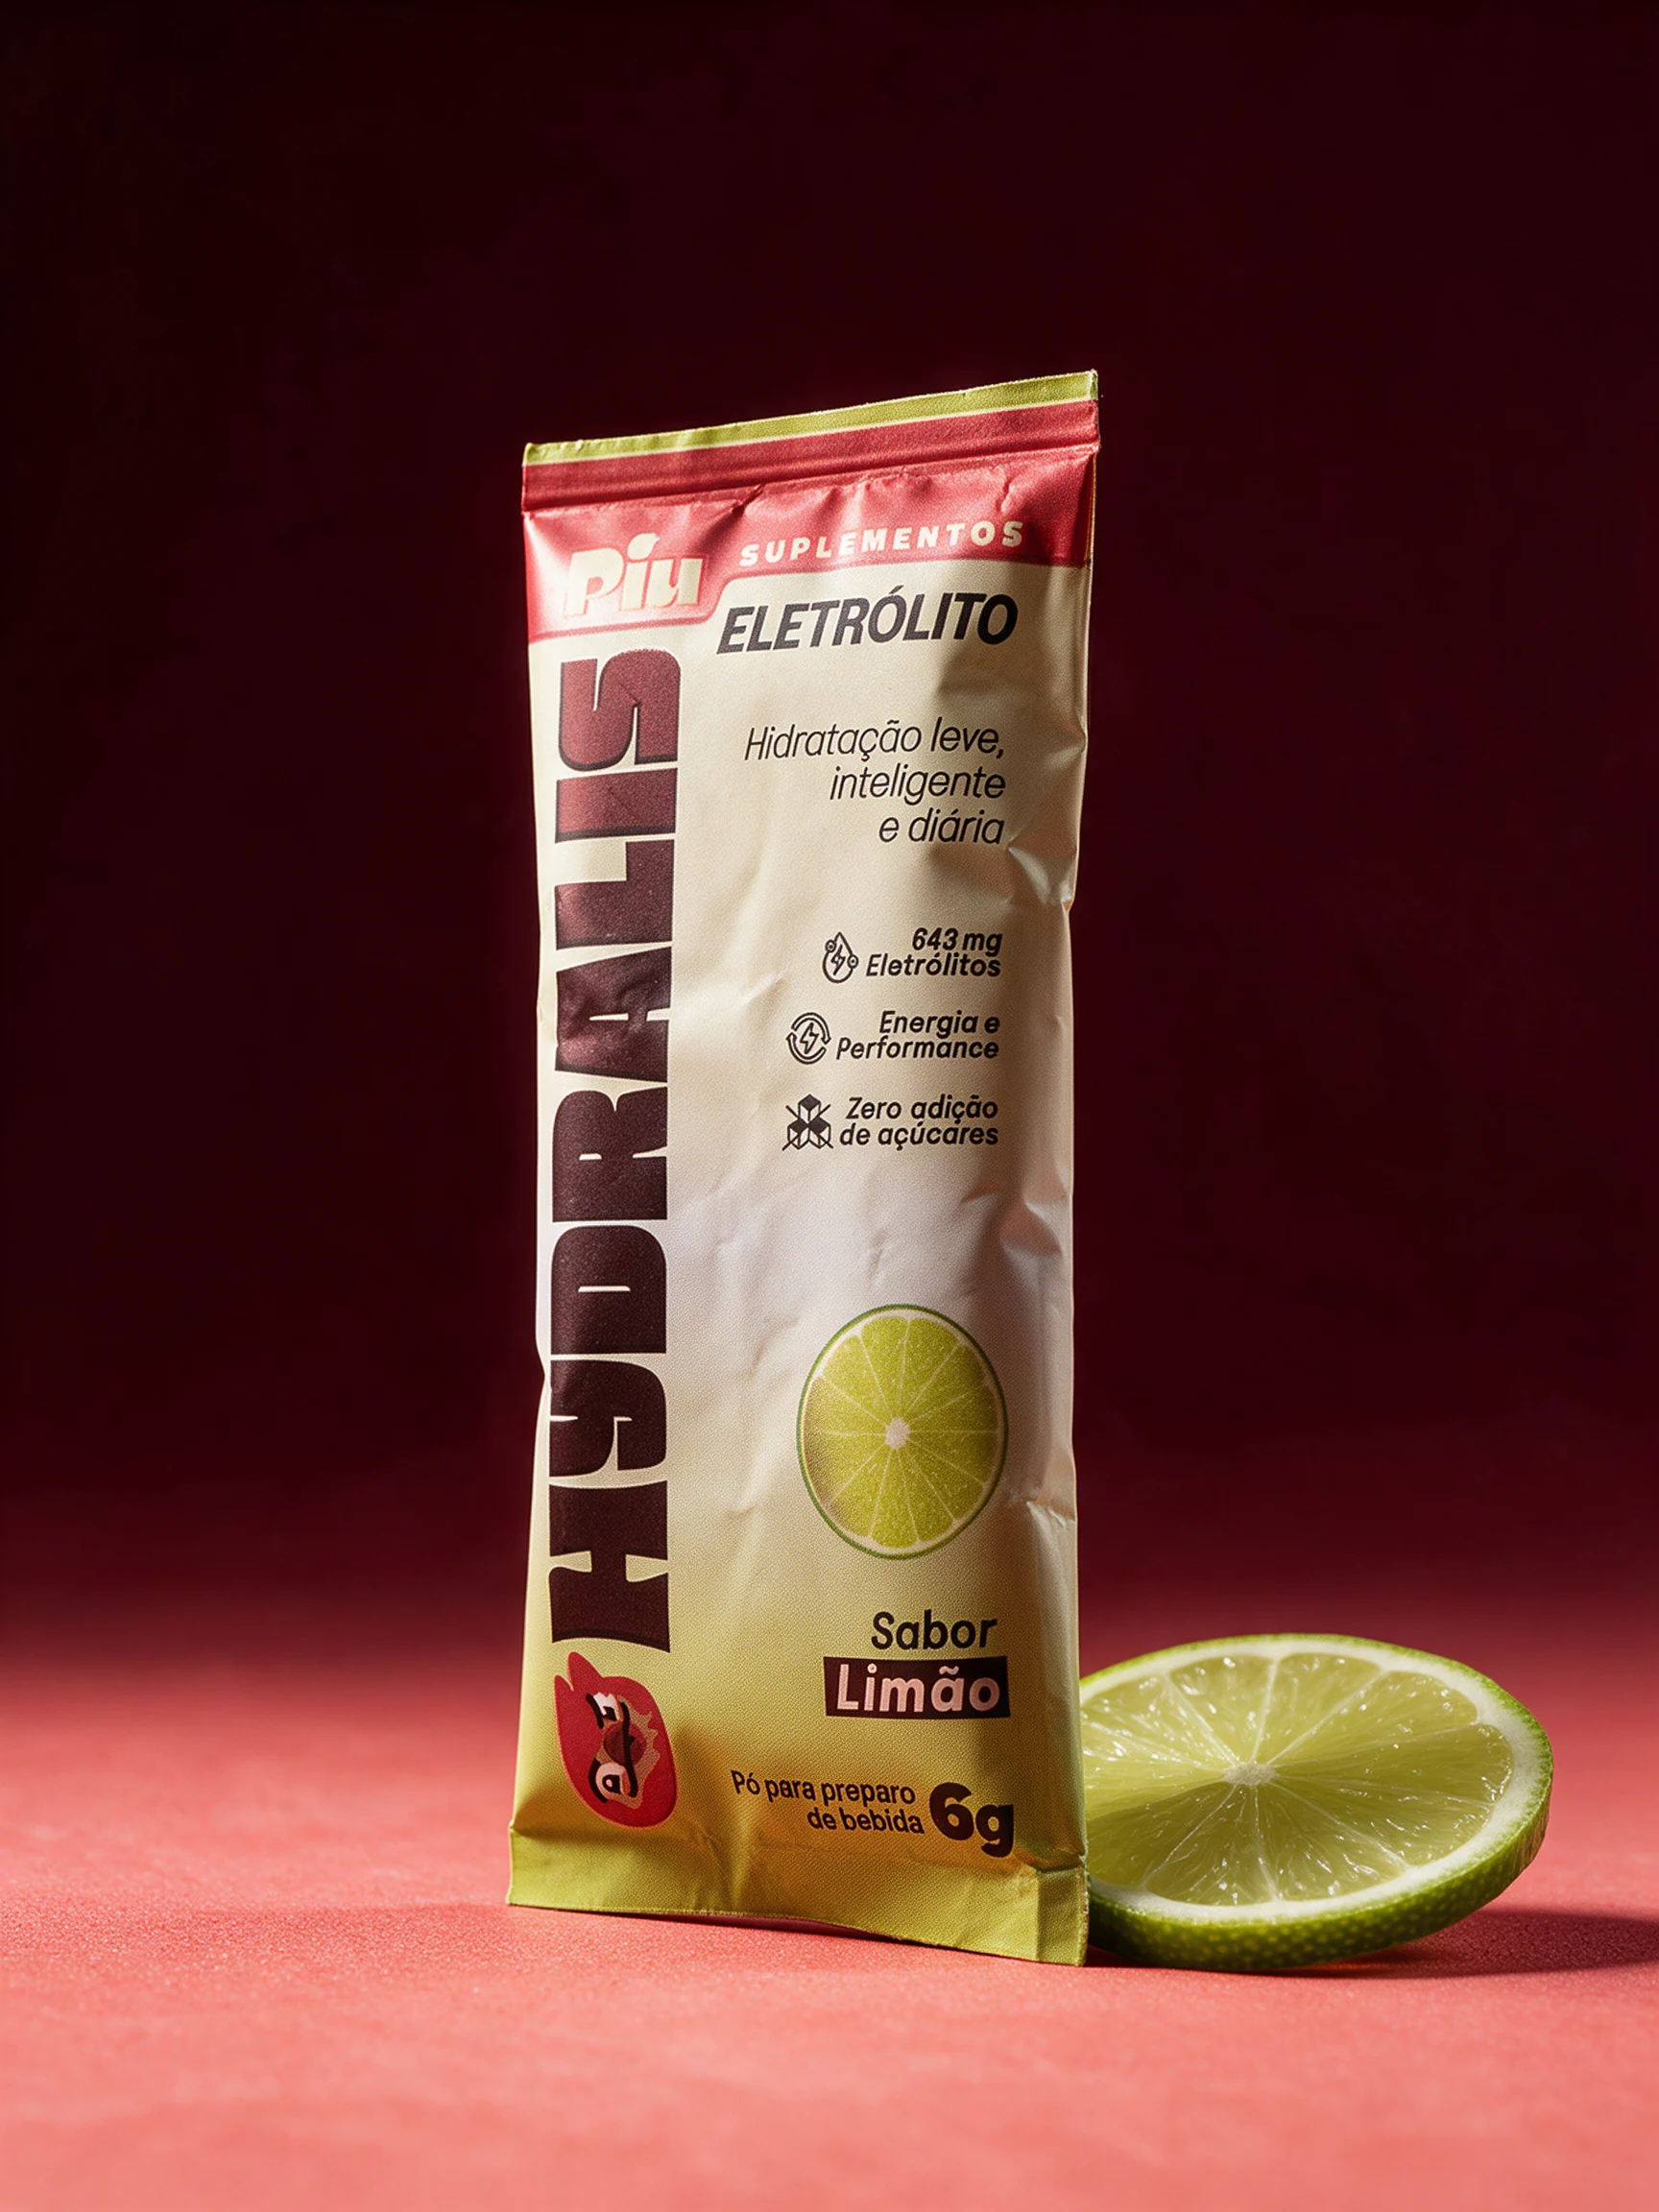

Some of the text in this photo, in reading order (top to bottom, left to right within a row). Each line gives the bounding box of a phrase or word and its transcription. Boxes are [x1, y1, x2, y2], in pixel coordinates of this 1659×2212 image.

[739, 520, 1022, 566] SUPLEMENTOS
[565, 533, 703, 615] Piu
[716, 585, 1019, 655] ELETRÓLITO
[744, 716, 1005, 761] Hidratação leve,
[830, 762, 1006, 805] inteligente
[878, 806, 1004, 845] e diária
[912, 927, 1002, 957] 643 mg
[866, 951, 1001, 977] Eletrólitos
[879, 1010, 1000, 1039] Energia e
[836, 1035, 999, 1060] Performance
[846, 1093, 998, 1124] Zero adição
[548, 648, 681, 1653] HYDRALIS
[839, 1121, 999, 1151] de açúcares
[871, 1609, 998, 1649] Sabor
[836, 1662, 1000, 1713] Limão
[731, 1770, 916, 1806] Pó para preparo
[806, 1807, 925, 1834] de bebida
[928, 1782, 1015, 1858] 6g
